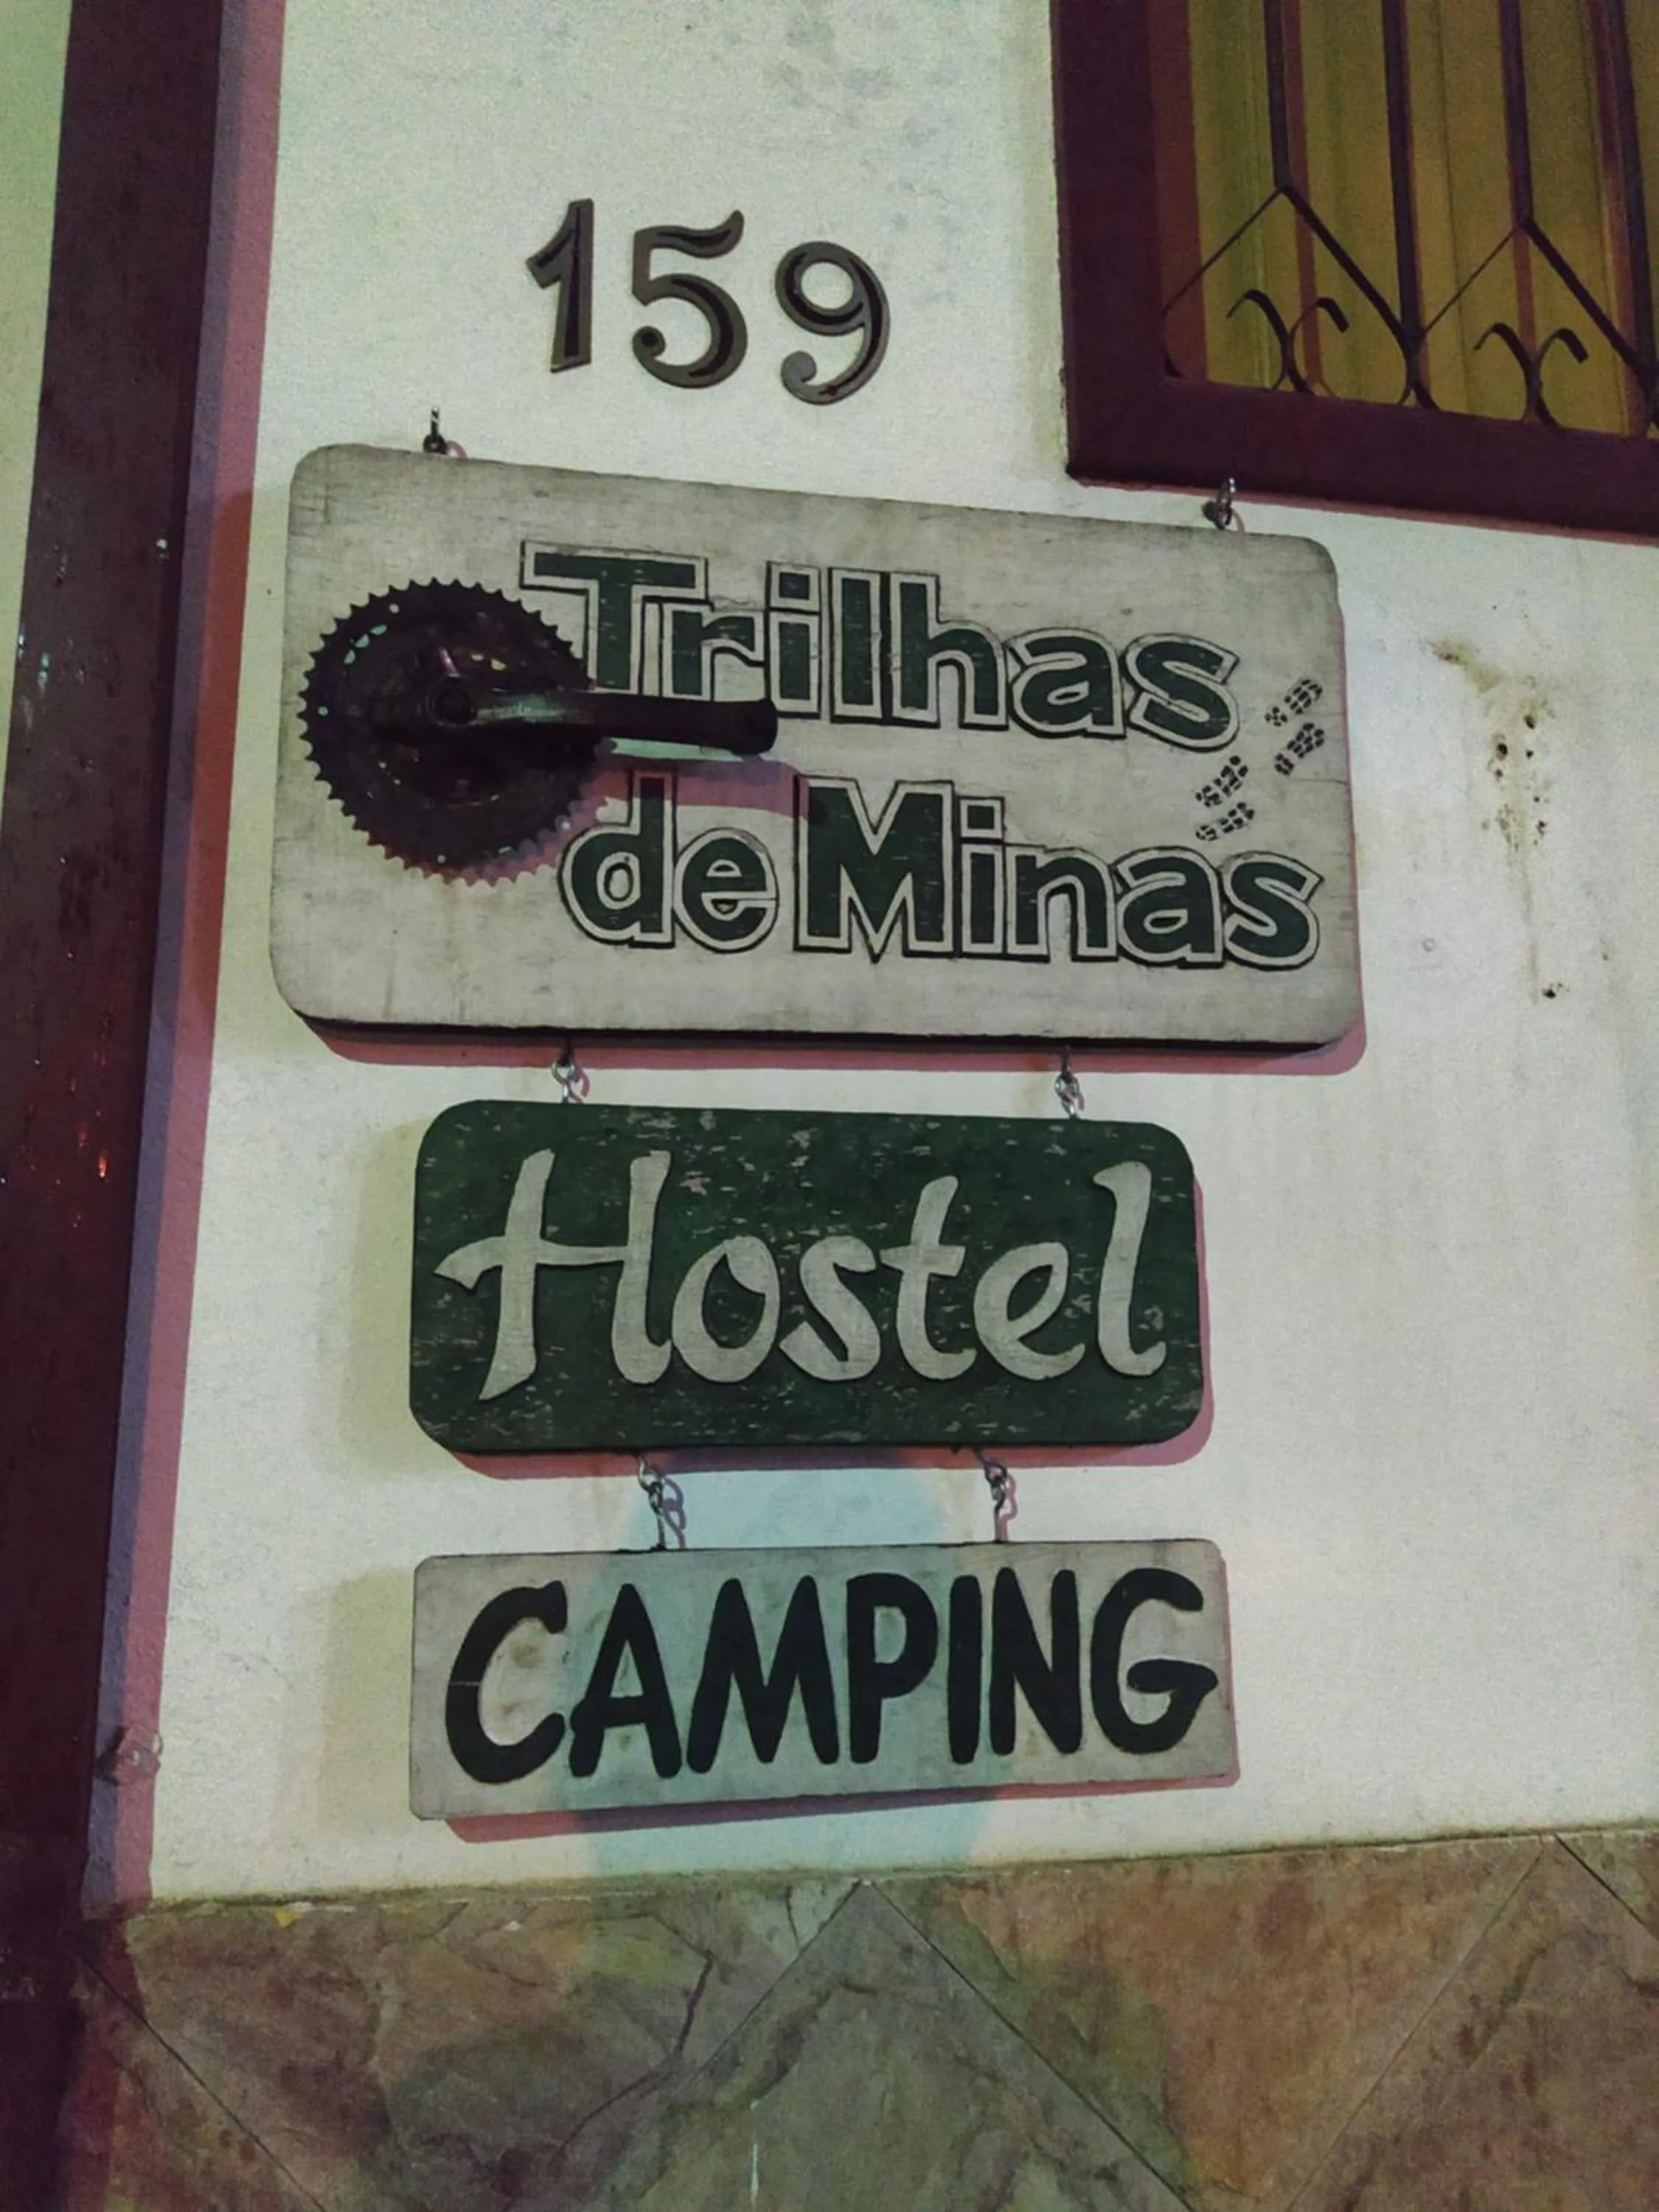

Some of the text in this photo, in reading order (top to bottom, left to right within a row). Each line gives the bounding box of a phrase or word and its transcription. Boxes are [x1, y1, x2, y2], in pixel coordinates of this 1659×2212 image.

[526, 198, 890, 406] 159
[521, 540, 1240, 753] Trilhas
[560, 771, 1324, 972] de Minas
[434, 1147, 1167, 1402] Hostel
[445, 1567, 1218, 1784] CAMPING
